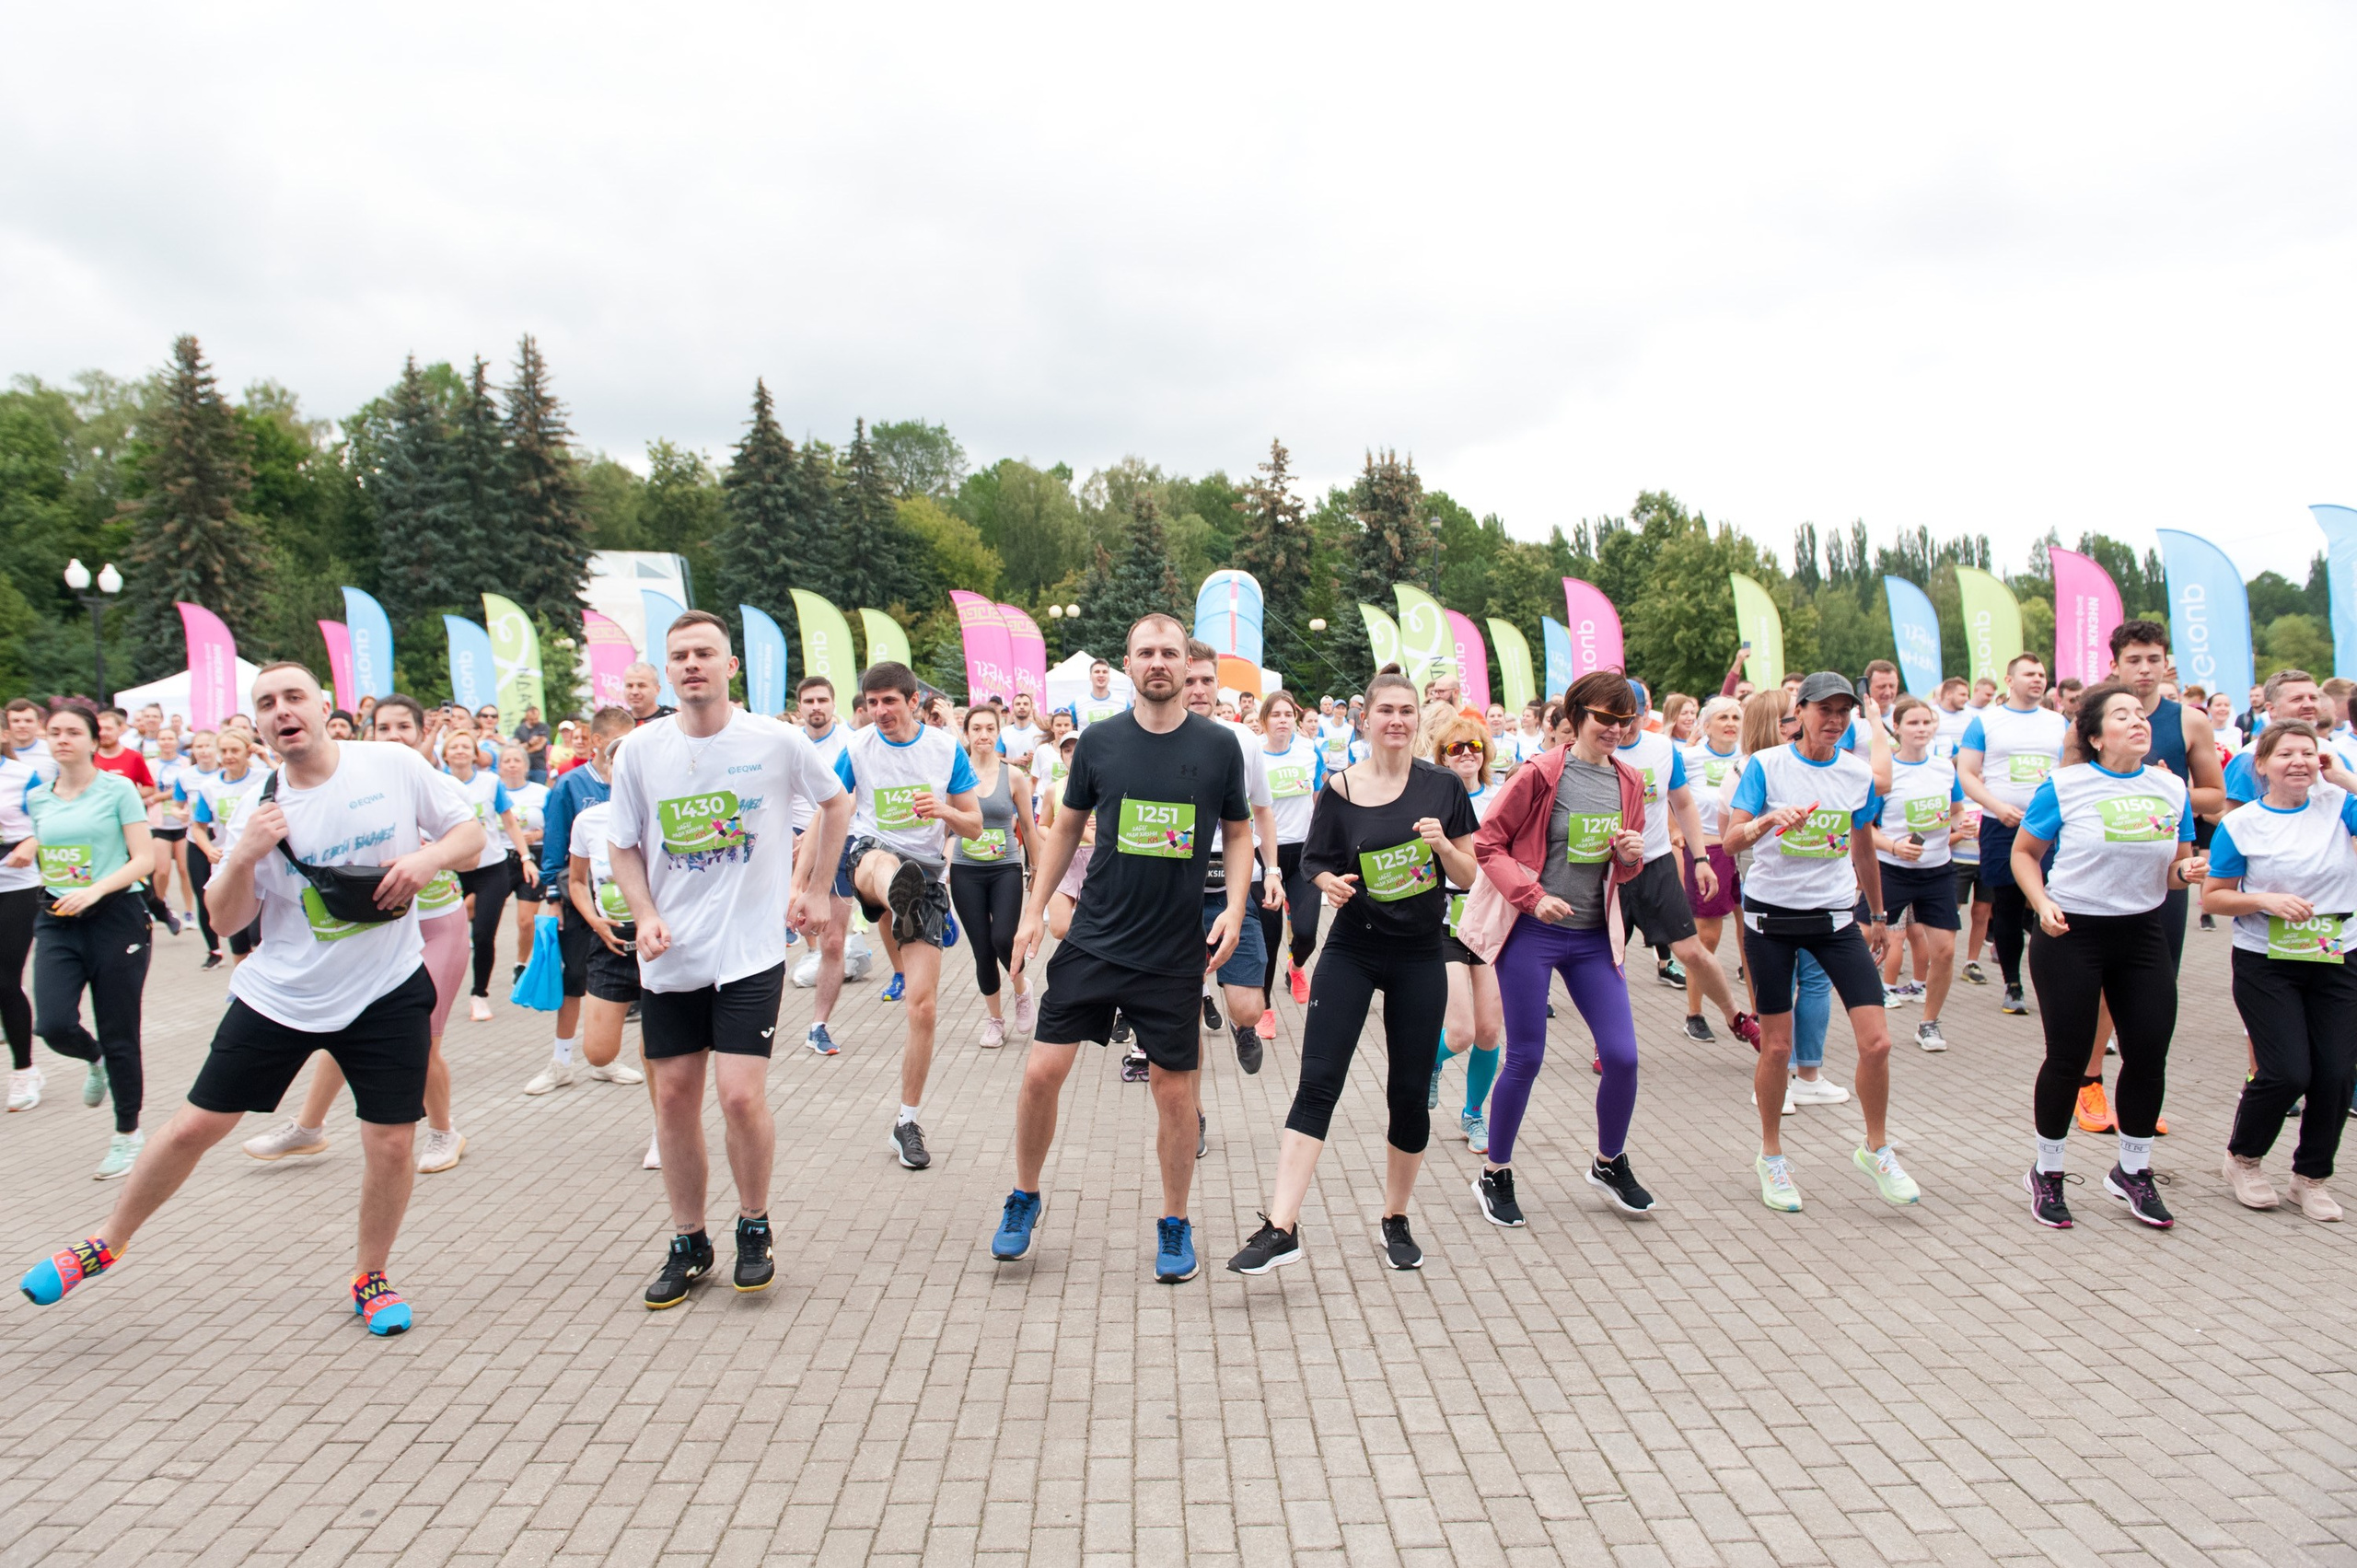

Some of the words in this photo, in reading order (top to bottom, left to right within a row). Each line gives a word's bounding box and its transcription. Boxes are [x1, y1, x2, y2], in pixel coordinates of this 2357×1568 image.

[736, 763, 763, 773] EQWA
[1277, 767, 1299, 779] 1119
[357, 793, 385, 807] EQWA
[670, 796, 726, 820] 1430
[1911, 797, 1943, 812] 1568
[2109, 798, 2155, 812] 1150
[1135, 804, 1178, 824] 1251
[1805, 812, 1842, 829] 407
[1582, 816, 1619, 833] 1276
[977, 831, 1000, 842] 94
[41, 848, 81, 862] 1405
[1372, 845, 1420, 871] 1252
[71, 1241, 100, 1272] WAN
[359, 1281, 391, 1300] WA
